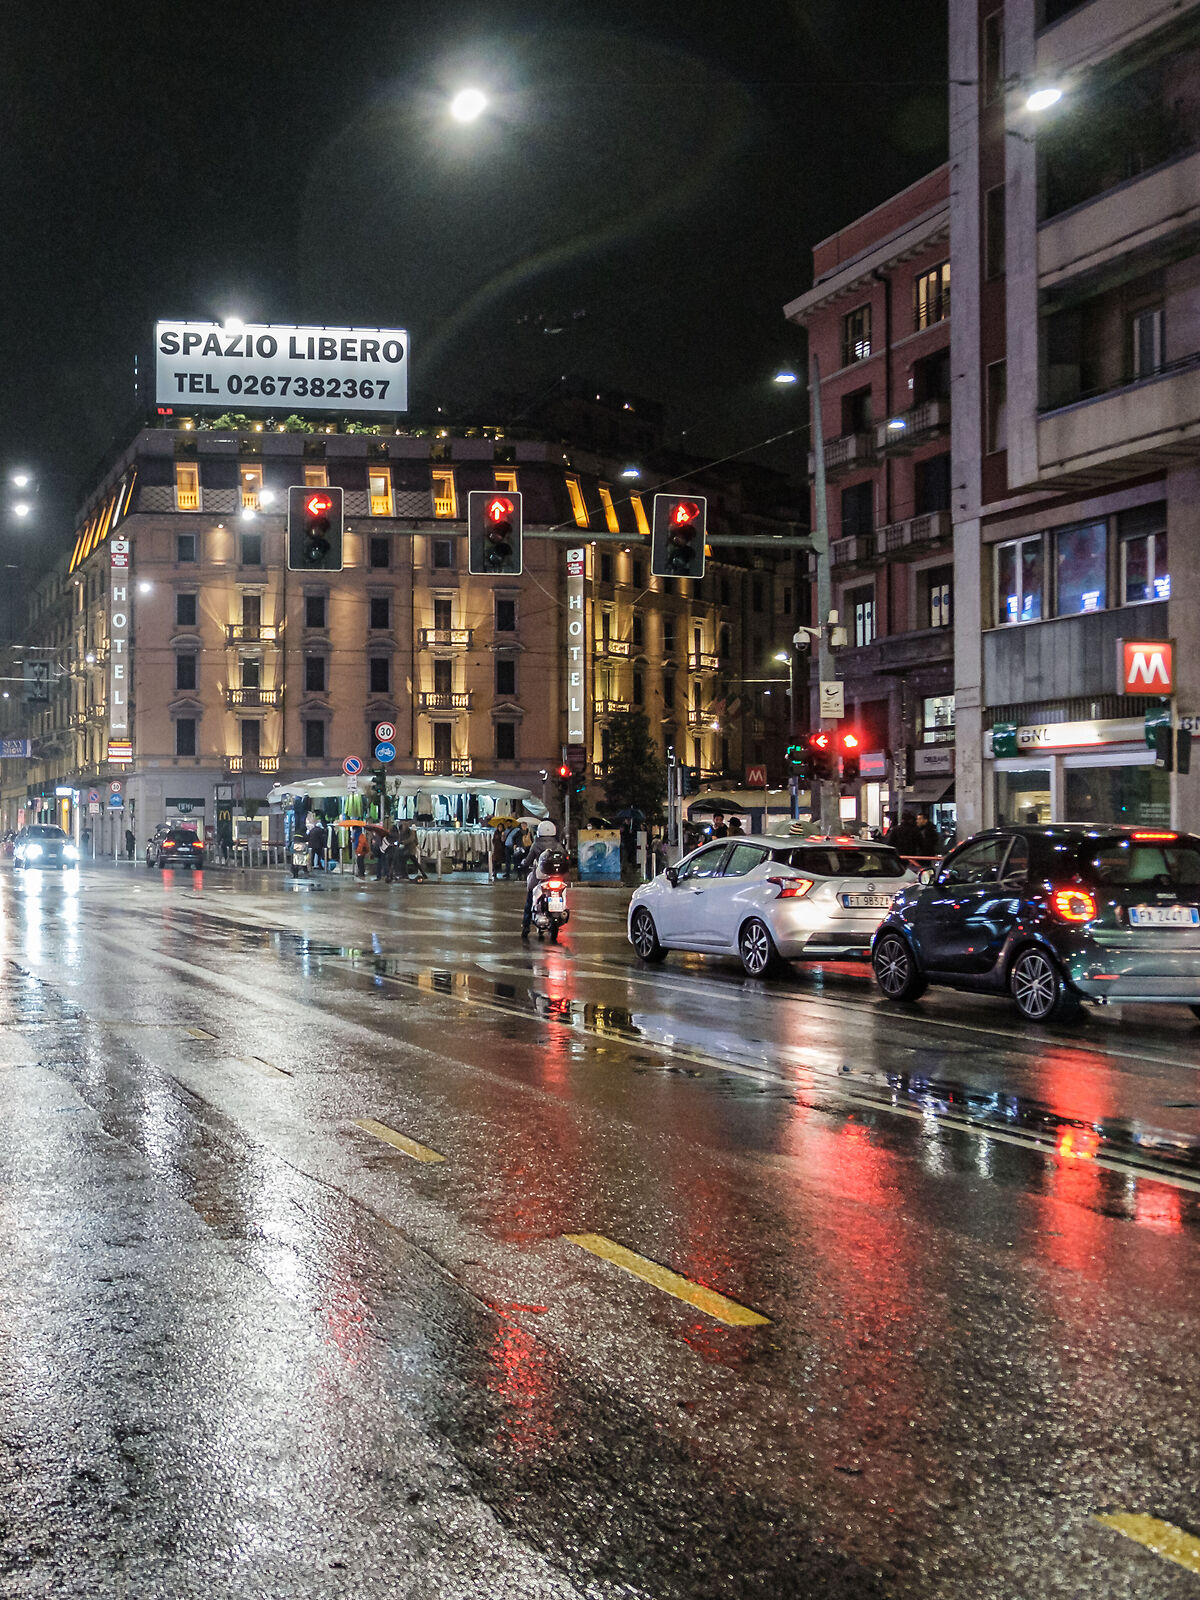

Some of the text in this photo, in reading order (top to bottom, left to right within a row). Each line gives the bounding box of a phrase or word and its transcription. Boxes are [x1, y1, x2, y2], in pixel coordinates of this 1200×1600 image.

[159, 331, 404, 363] SPAZIO LIBERO
[174, 373, 390, 400] TEL 0267382367
[112, 587, 126, 705] HOTEL
[569, 595, 583, 712] HOTEL
[1127, 652, 1170, 684] M
[380, 727, 392, 737] 30
[1021, 729, 1052, 743] BNL
[748, 770, 763, 782] M
